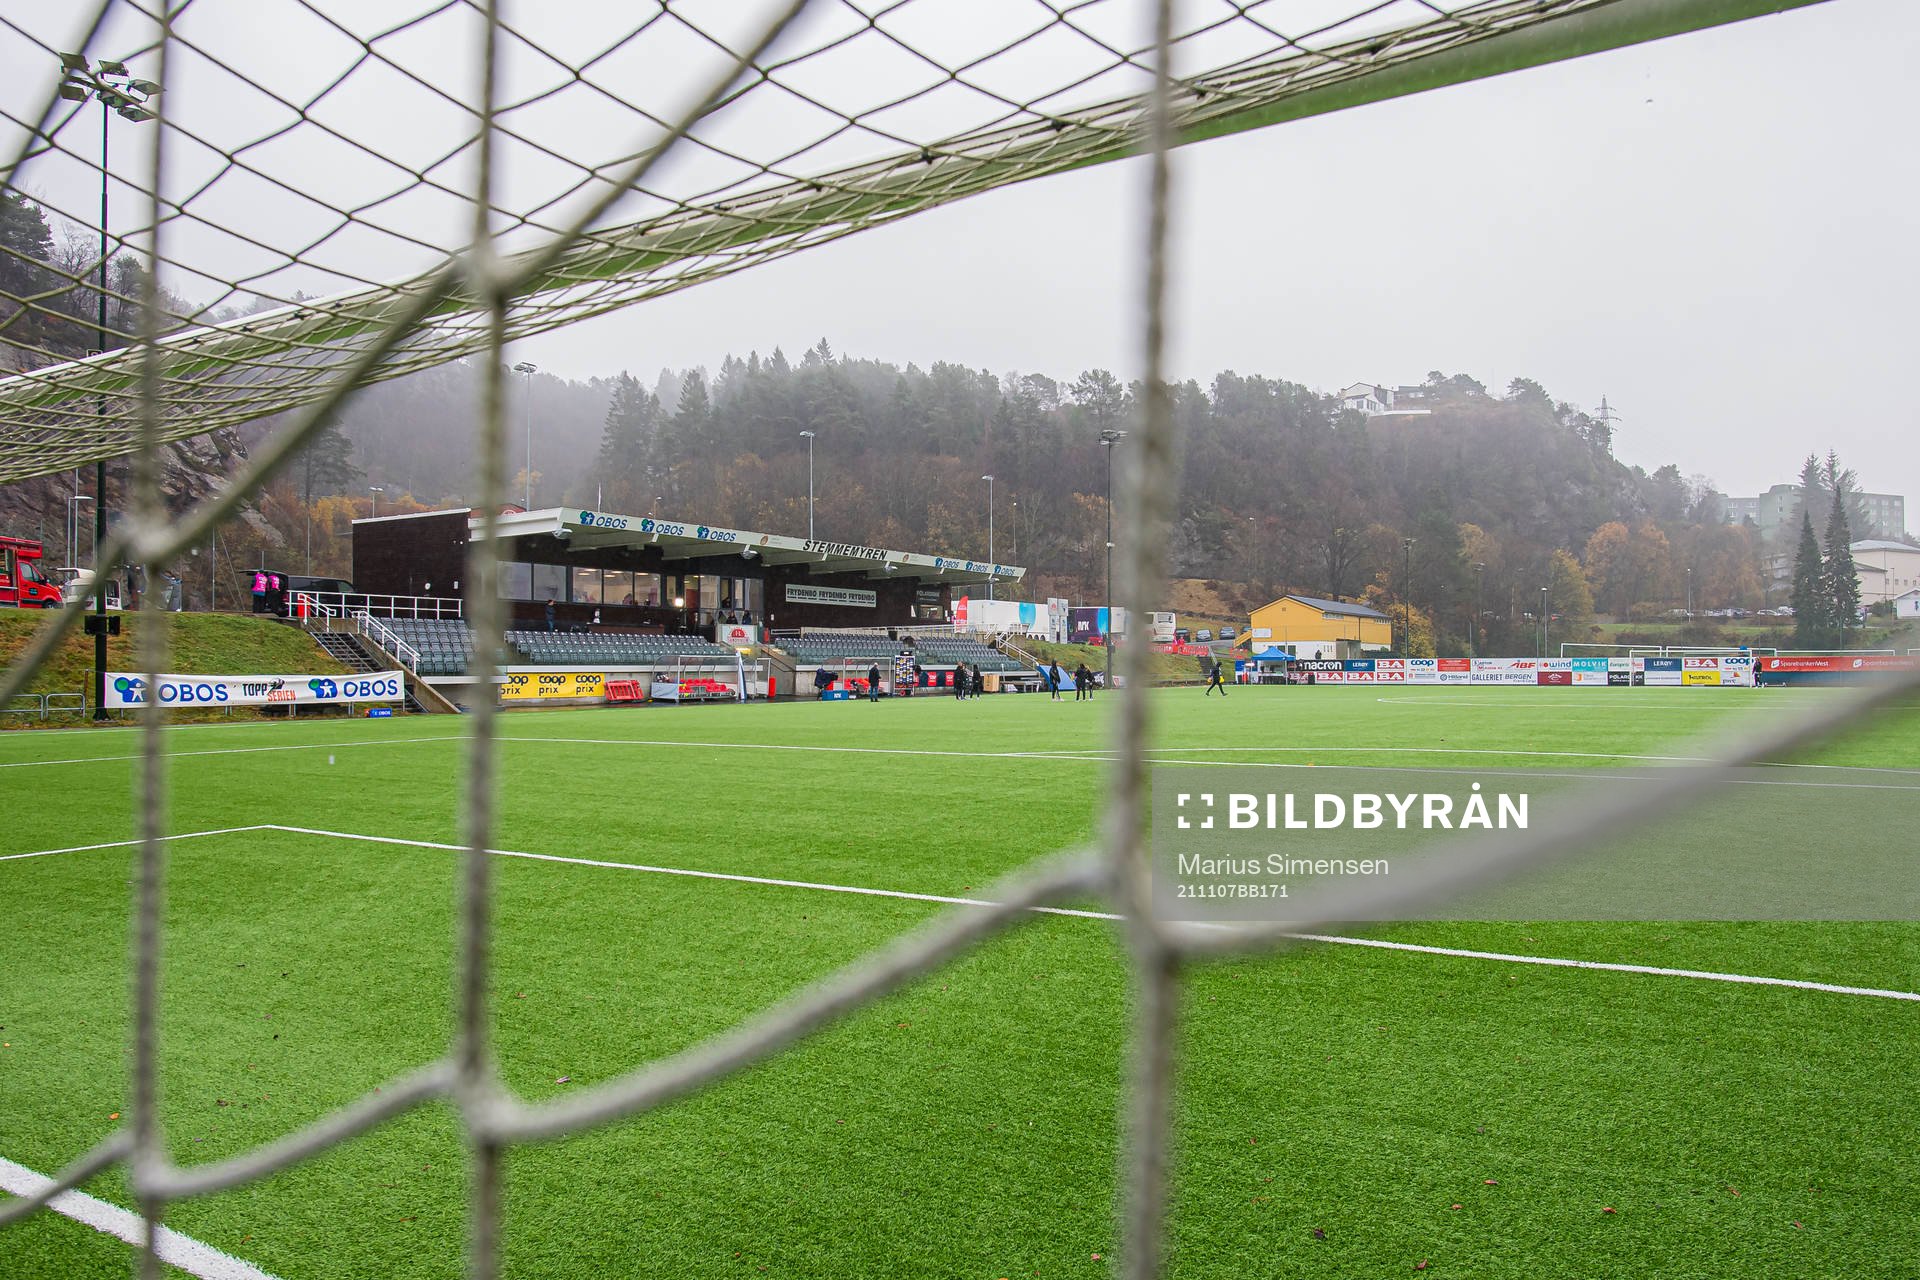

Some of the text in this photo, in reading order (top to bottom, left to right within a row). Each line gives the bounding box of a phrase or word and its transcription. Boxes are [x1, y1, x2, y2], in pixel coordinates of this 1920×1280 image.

[596, 516, 628, 529] OBOS
[655, 523, 684, 536] OBOS
[710, 530, 737, 542] OBOS
[803, 540, 888, 560] STEMMEMYREN
[787, 588, 817, 598] FRYDENBO
[1378, 660, 1404, 668] BA
[1685, 660, 1718, 668] BA
[508, 674, 602, 686] oop coop coop
[1317, 672, 1342, 680] BA
[1347, 672, 1374, 680] BA
[1377, 672, 1404, 680] BA
[159, 683, 229, 702] OBOS
[242, 683, 268, 697] TOPP
[343, 679, 398, 698] OBOS
[538, 684, 559, 696] prix
[575, 683, 594, 695] prix
[268, 690, 297, 702] SERIEN
